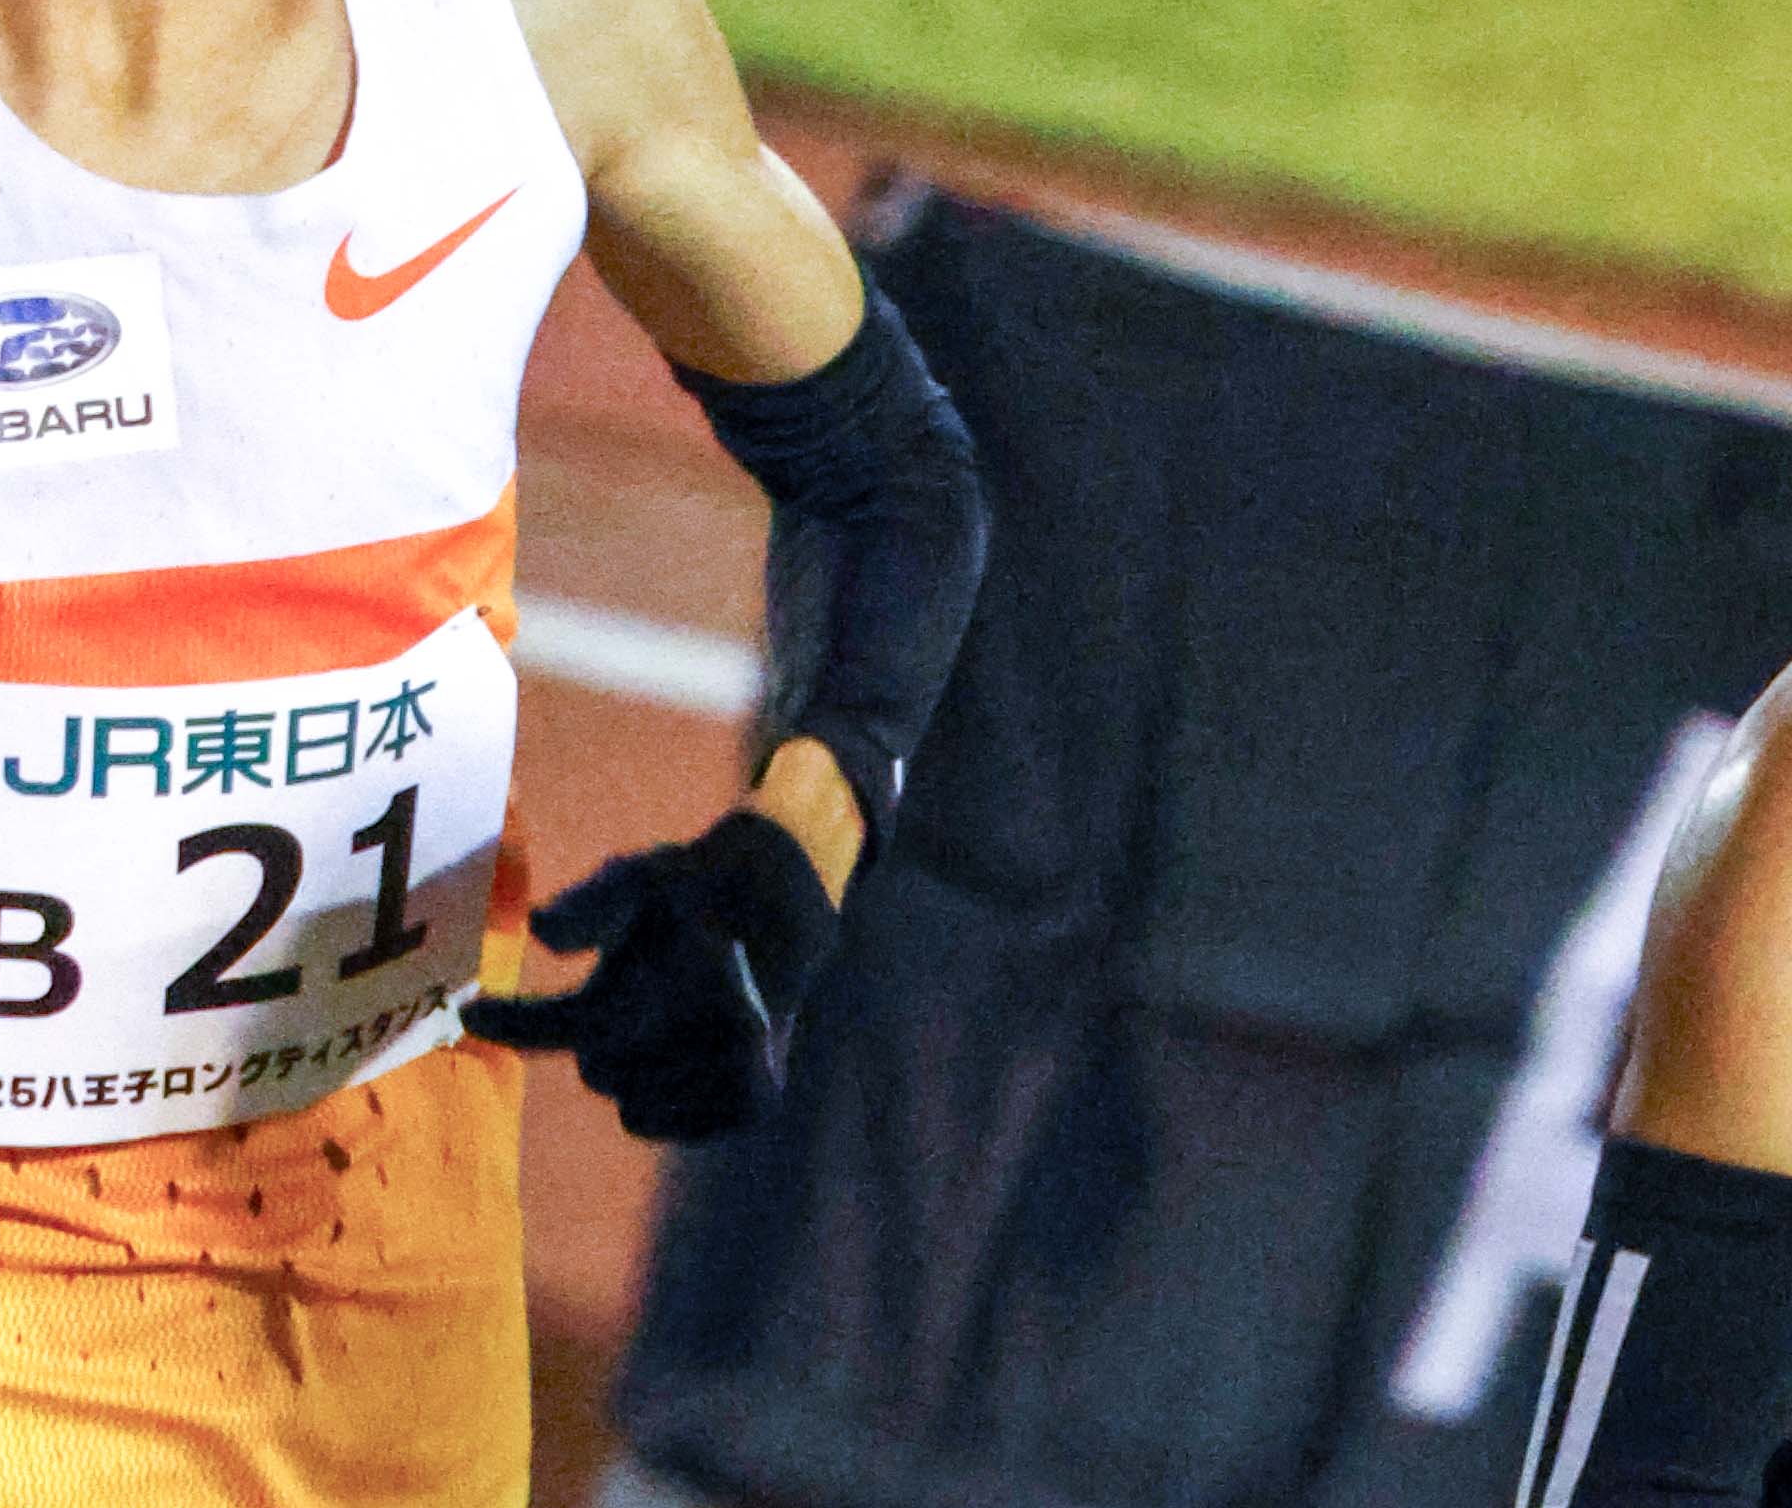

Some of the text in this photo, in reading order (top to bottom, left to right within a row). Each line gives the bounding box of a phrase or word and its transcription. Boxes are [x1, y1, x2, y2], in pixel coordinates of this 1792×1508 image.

[3, 680, 437, 799] JR東日本
[163, 782, 428, 1017] 21
